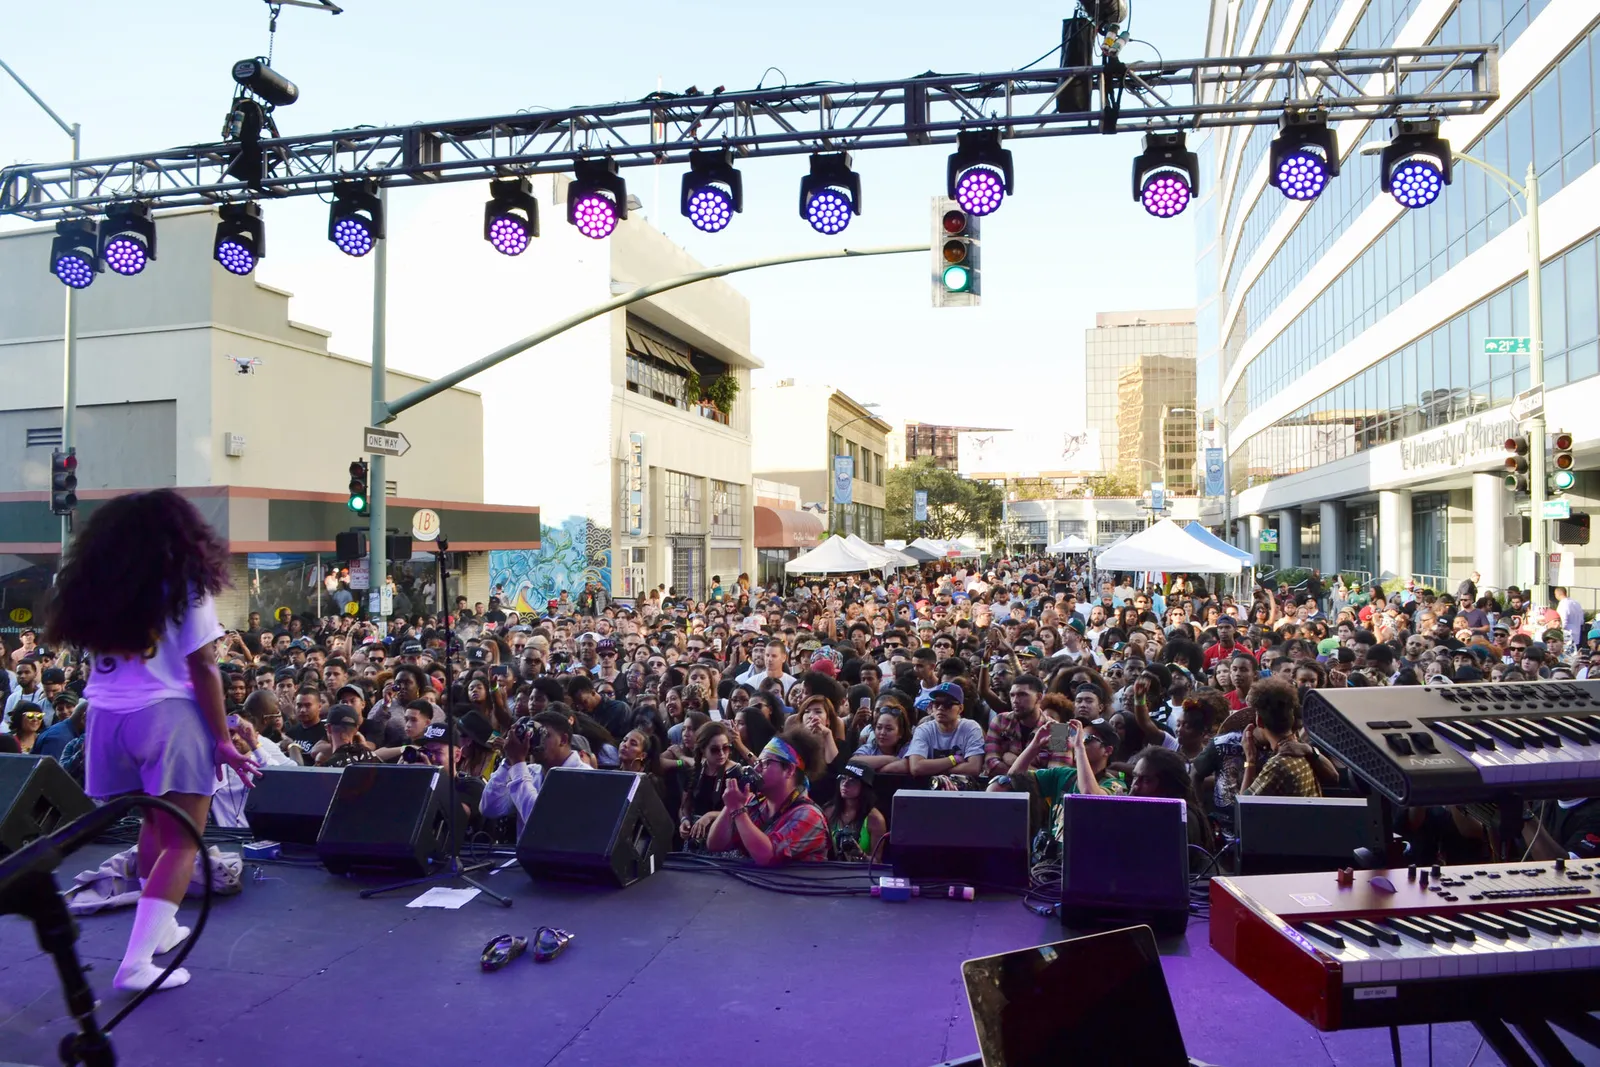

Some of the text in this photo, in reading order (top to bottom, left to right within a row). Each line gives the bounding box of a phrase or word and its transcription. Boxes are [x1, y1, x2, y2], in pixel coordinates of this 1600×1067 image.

[368, 435, 398, 449] ONE WAY
[1409, 429, 1457, 466] University
[1457, 420, 1471, 455] of
[1551, 554, 1560, 562] NO
[1409, 757, 1456, 766] Axiom
